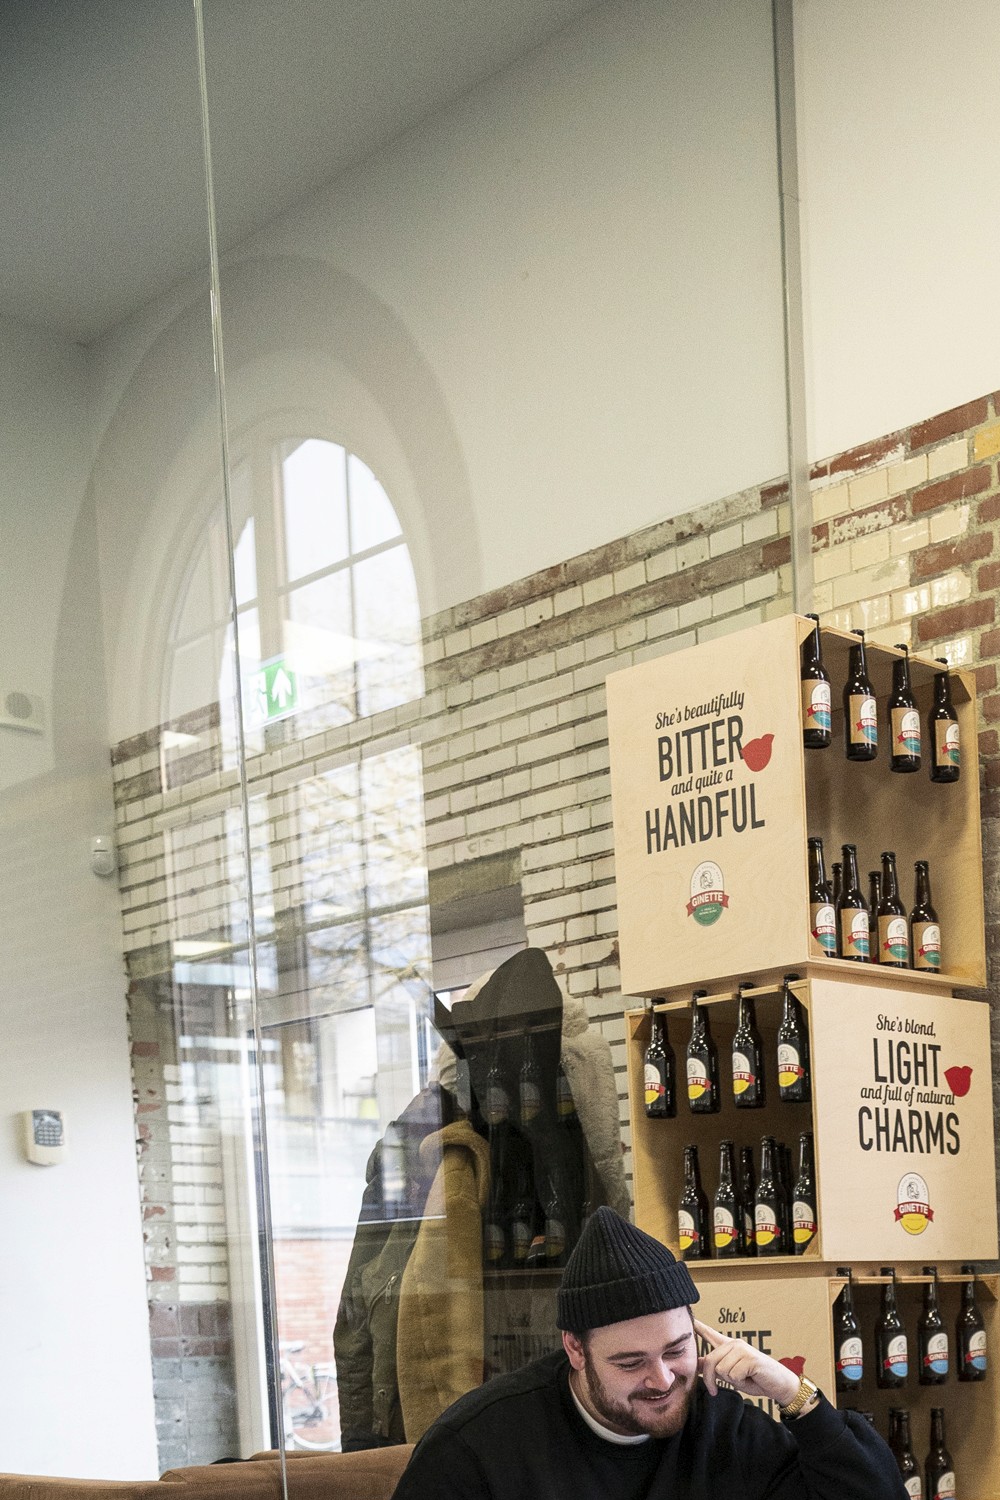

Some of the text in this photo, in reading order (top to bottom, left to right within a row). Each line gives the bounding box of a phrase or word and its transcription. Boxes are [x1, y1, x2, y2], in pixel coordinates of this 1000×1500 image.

[655, 690, 745, 730] She's beautifully
[658, 715, 744, 782] BITTER
[671, 769, 733, 796] and quite a
[645, 783, 765, 855] HANDFUL
[691, 891, 723, 907] GINETTE
[876, 1014, 936, 1039] She's blond,
[873, 1037, 942, 1088] LIGHT
[860, 1084, 956, 1107] and full of natural
[858, 1105, 961, 1156] CHARMS
[899, 1203, 929, 1215] GINETTE
[718, 1307, 746, 1324] She's
